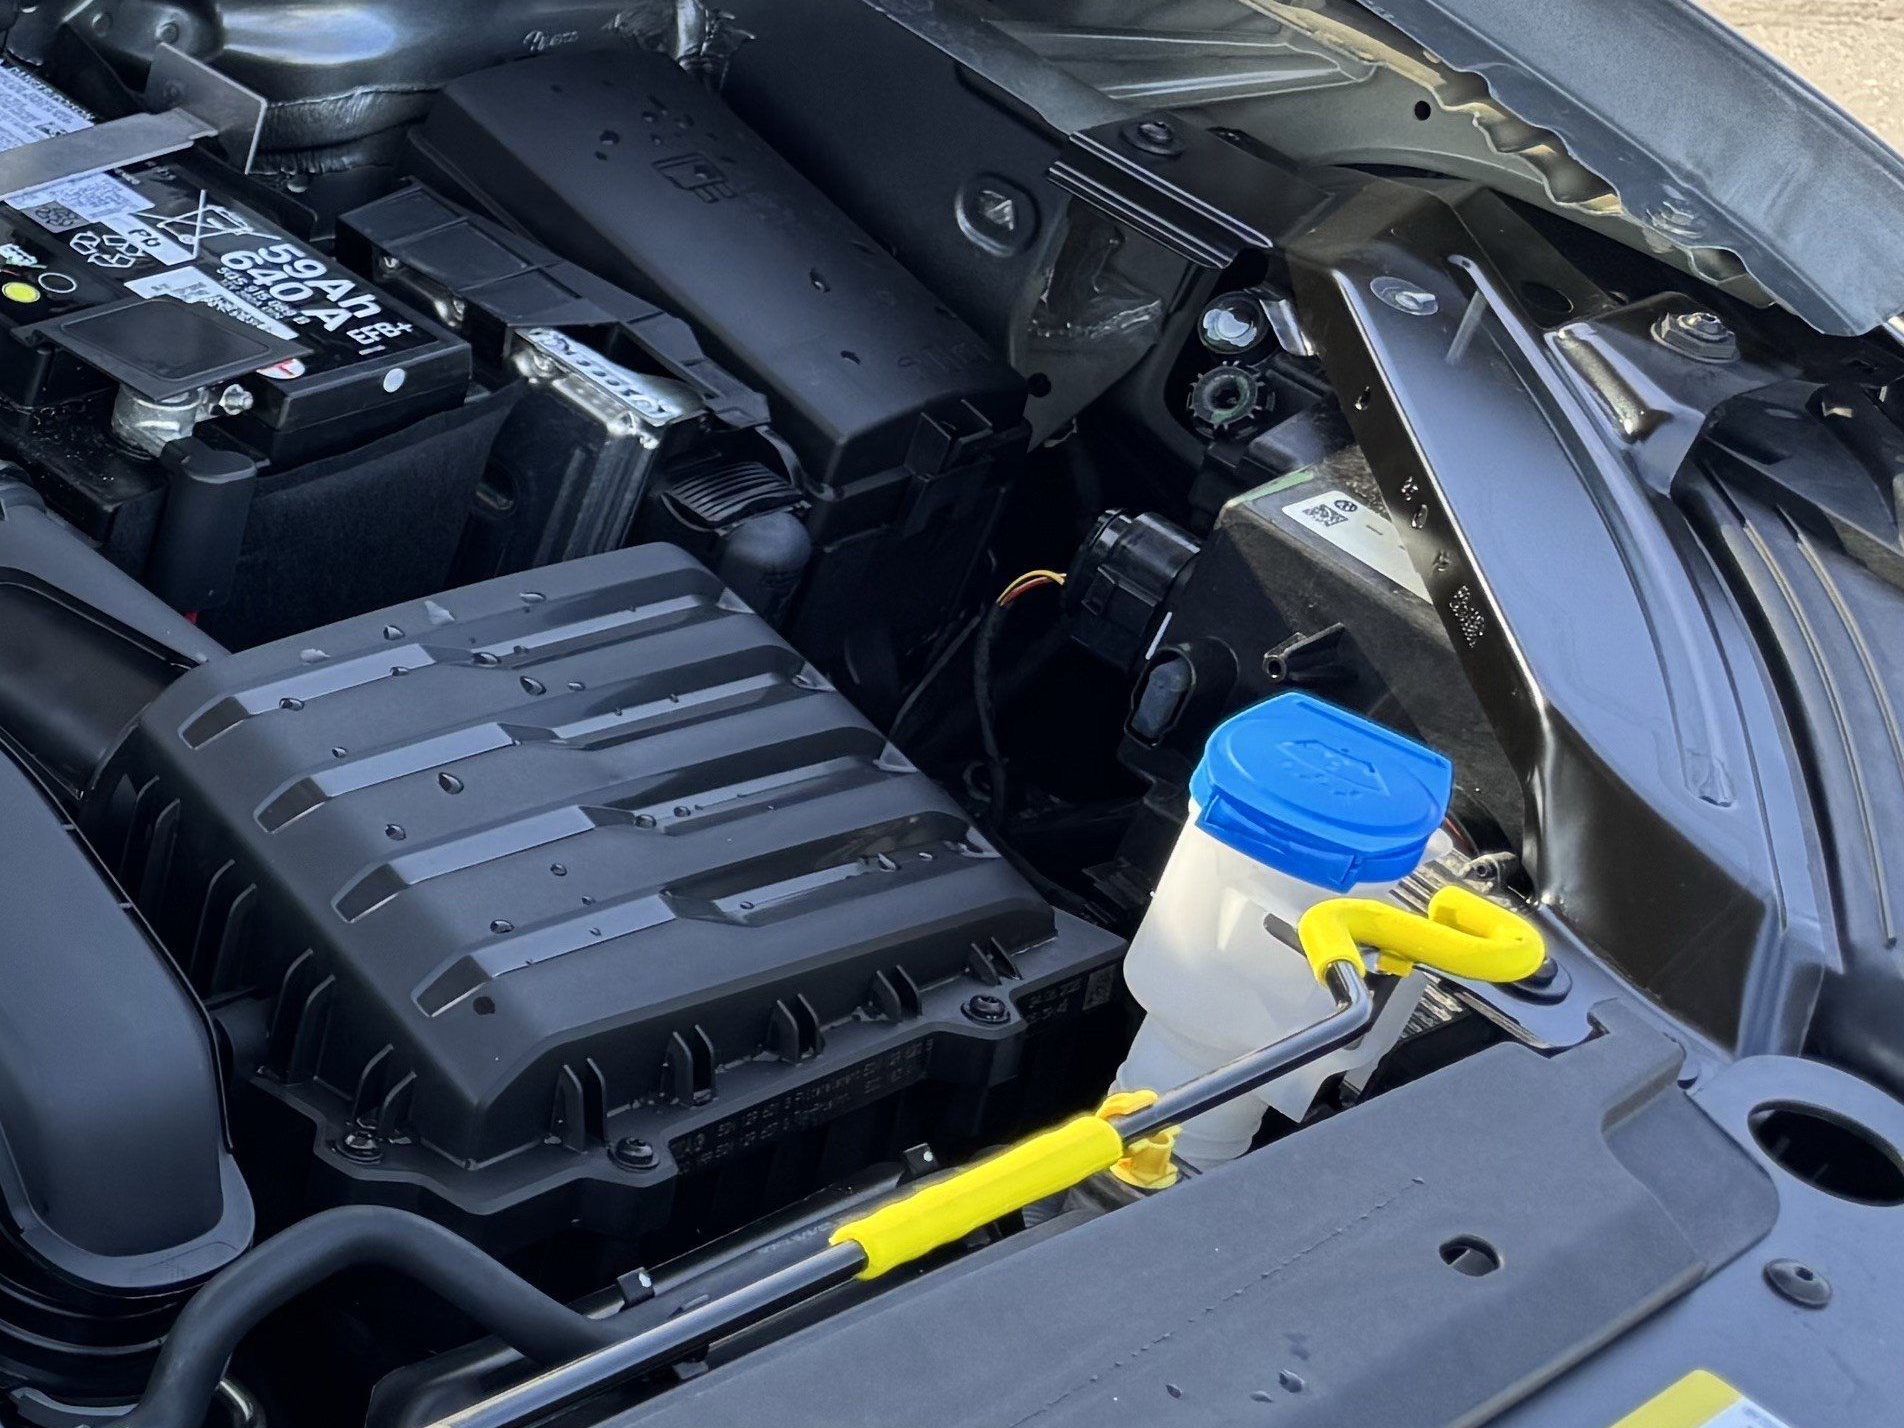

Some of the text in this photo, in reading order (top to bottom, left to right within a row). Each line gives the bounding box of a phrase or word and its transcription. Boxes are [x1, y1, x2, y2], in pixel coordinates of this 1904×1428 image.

[221, 249, 313, 302] 640
[306, 307, 353, 333] A
[263, 243, 382, 317] 59Ah
[346, 321, 414, 346] EFB+
